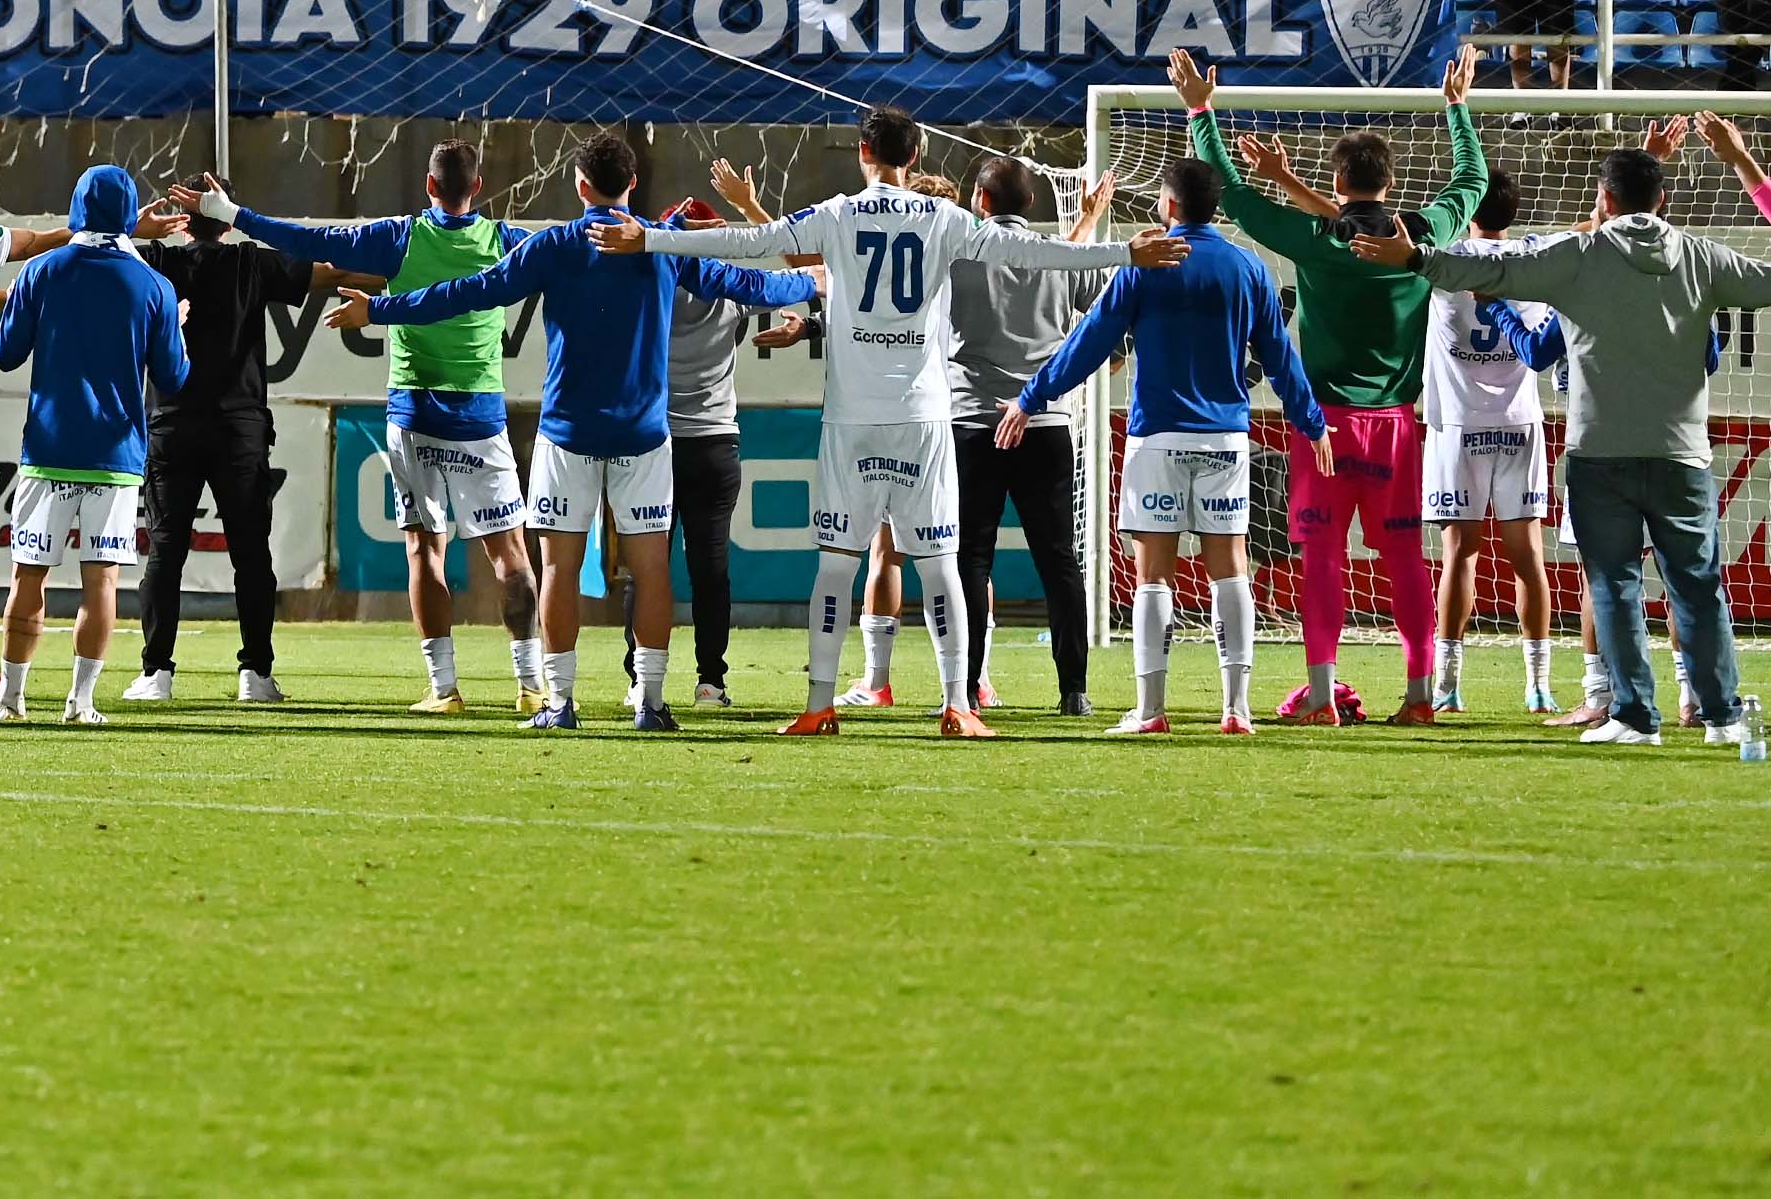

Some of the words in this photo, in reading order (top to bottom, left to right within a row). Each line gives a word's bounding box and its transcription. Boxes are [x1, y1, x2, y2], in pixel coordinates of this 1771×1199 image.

[856, 230, 925, 314] 70
[1463, 431, 1527, 448] PETROLINA
[415, 445, 485, 469] PETROLINA
[449, 464, 475, 475] FUELS
[857, 456, 921, 478] PETROLINA
[863, 472, 890, 483] ITALOS
[891, 475, 915, 488] FUELS
[1142, 492, 1185, 511] deli
[1428, 490, 1470, 507] deli
[813, 509, 850, 534] deli
[1153, 514, 1178, 522] TOOLS
[17, 529, 52, 553] deli
